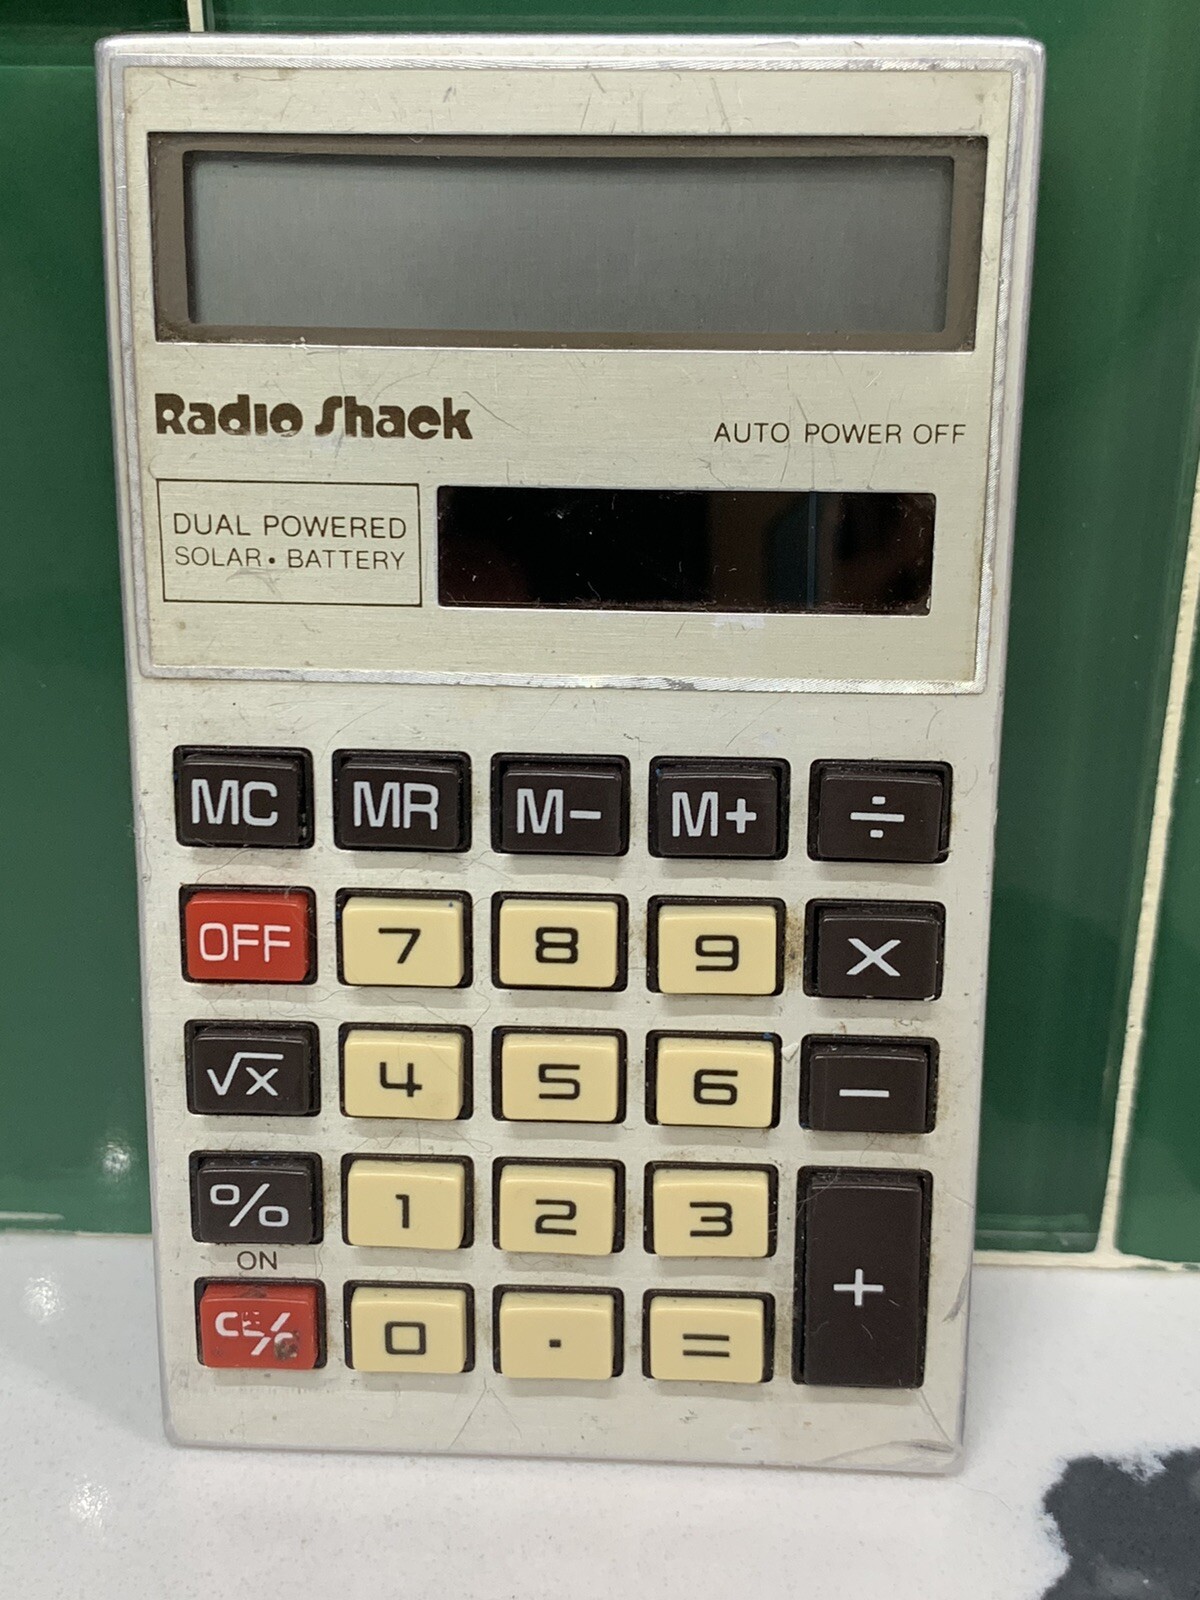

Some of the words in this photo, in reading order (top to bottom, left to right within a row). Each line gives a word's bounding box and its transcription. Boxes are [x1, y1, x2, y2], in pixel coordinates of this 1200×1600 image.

[154, 393, 304, 436] Radio
[314, 395, 473, 440] Shack
[714, 422, 790, 444] AUTO
[805, 423, 902, 444] POWER
[913, 424, 966, 445] OFF
[173, 512, 251, 537] DUAL
[263, 514, 407, 539] POWERED
[288, 549, 405, 571] BATTERY
[191, 778, 278, 826] MC
[353, 781, 439, 831] MR
[672, 791, 757, 838] M+
[199, 922, 291, 963] OFF
[378, 927, 421, 964] 7
[535, 927, 579, 964] 8
[695, 934, 740, 972] 9
[379, 1061, 422, 1098] 4
[538, 1064, 581, 1100] 5
[693, 1069, 738, 1105] 6
[209, 1183, 289, 1228] %
[395, 1194, 410, 1229] 1
[534, 1198, 577, 1236] 2
[689, 1201, 733, 1237] 3
[236, 1250, 277, 1270] ON
[833, 1268, 884, 1307] +
[385, 1321, 426, 1355] 0
[682, 1333, 730, 1358] =
